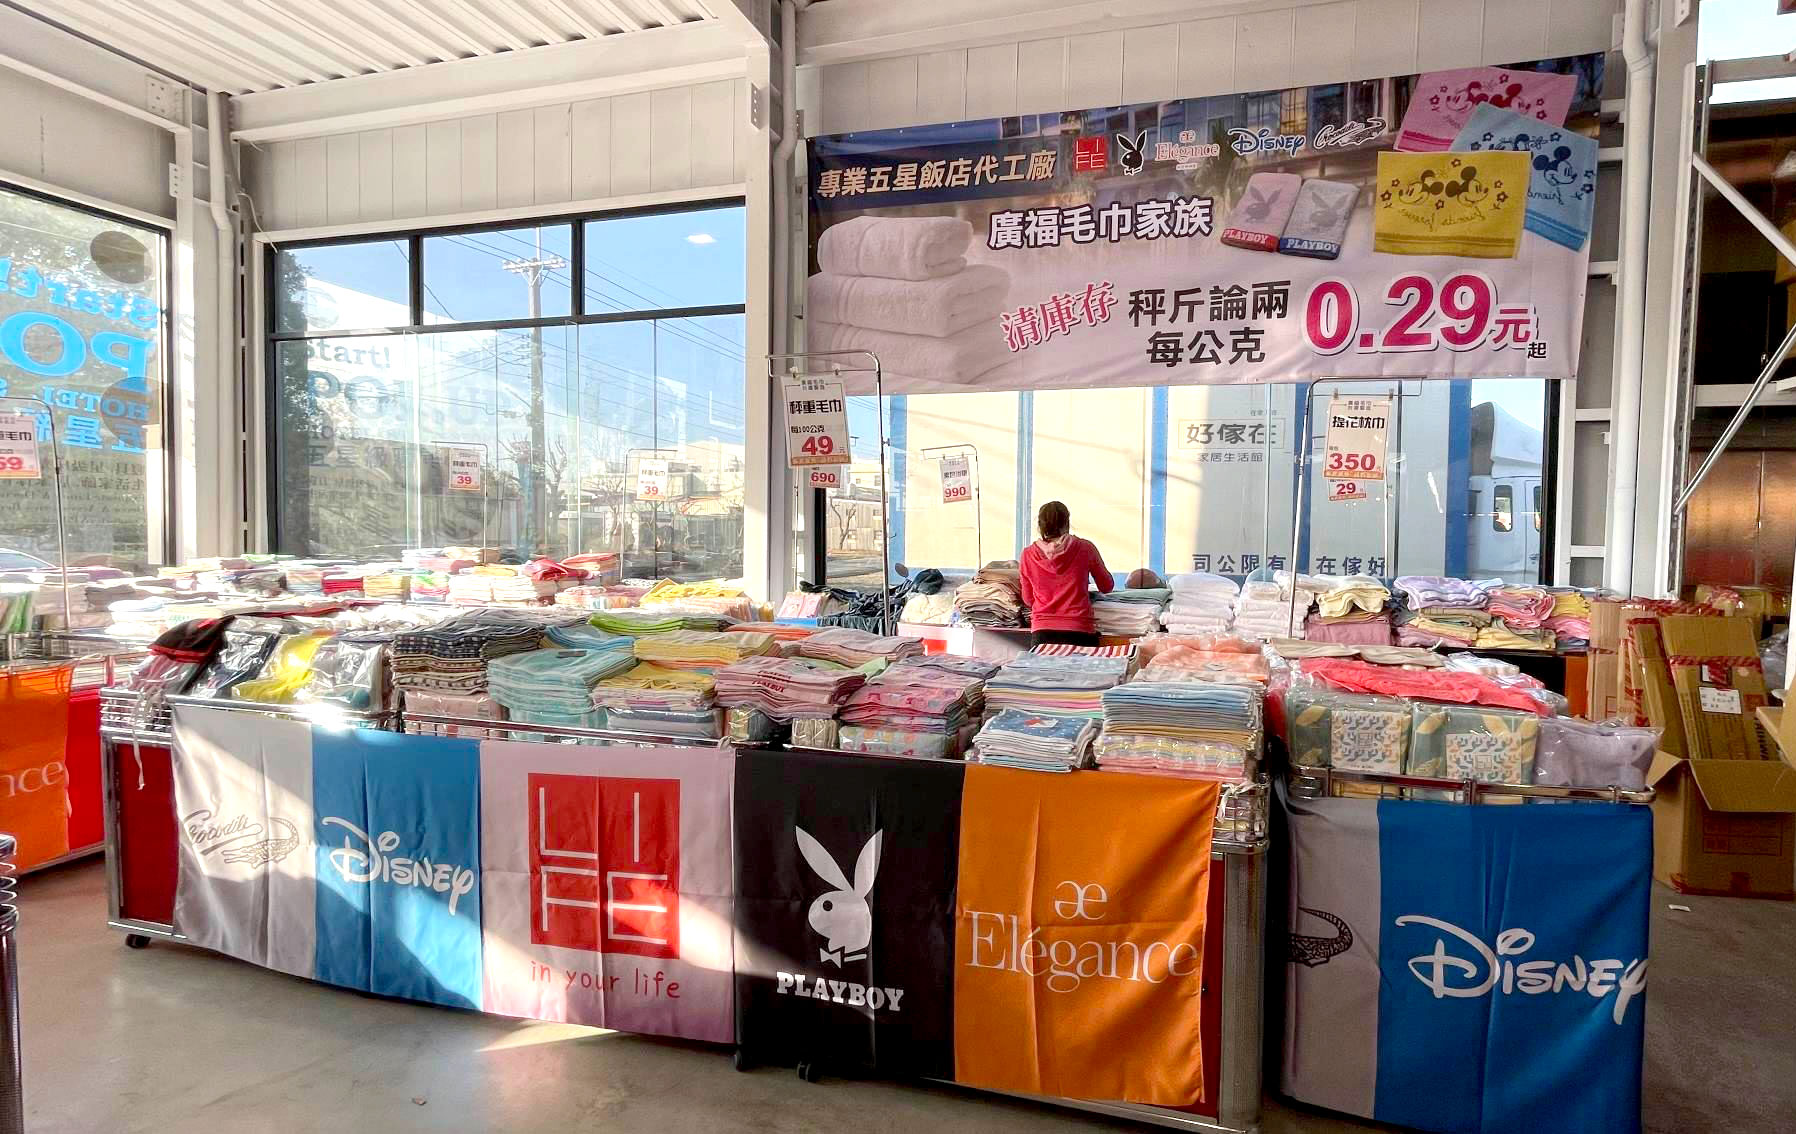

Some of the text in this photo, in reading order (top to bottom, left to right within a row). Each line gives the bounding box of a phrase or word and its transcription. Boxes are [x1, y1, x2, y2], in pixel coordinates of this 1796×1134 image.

[817, 148, 1058, 199] 專業五星飯店代工廠
[988, 197, 1214, 250] 廣福毛巾家族
[1223, 228, 1268, 245] PLAYBOY
[1286, 239, 1339, 254] PLAYBOY
[1001, 280, 1118, 353] 清庫存
[1127, 280, 1292, 329] 秤斤論兩
[1145, 326, 1267, 367] 每公克
[1328, 452, 1376, 471] 350
[456, 475, 472, 485] 39
[644, 485, 659, 496] 39
[811, 471, 836, 483] 690
[1336, 482, 1356, 495] 29
[944, 486, 967, 498] 990
[964, 909, 1198, 993] Elégance
[531, 960, 681, 999] in your life
[776, 971, 905, 1012] PLAYBOY
